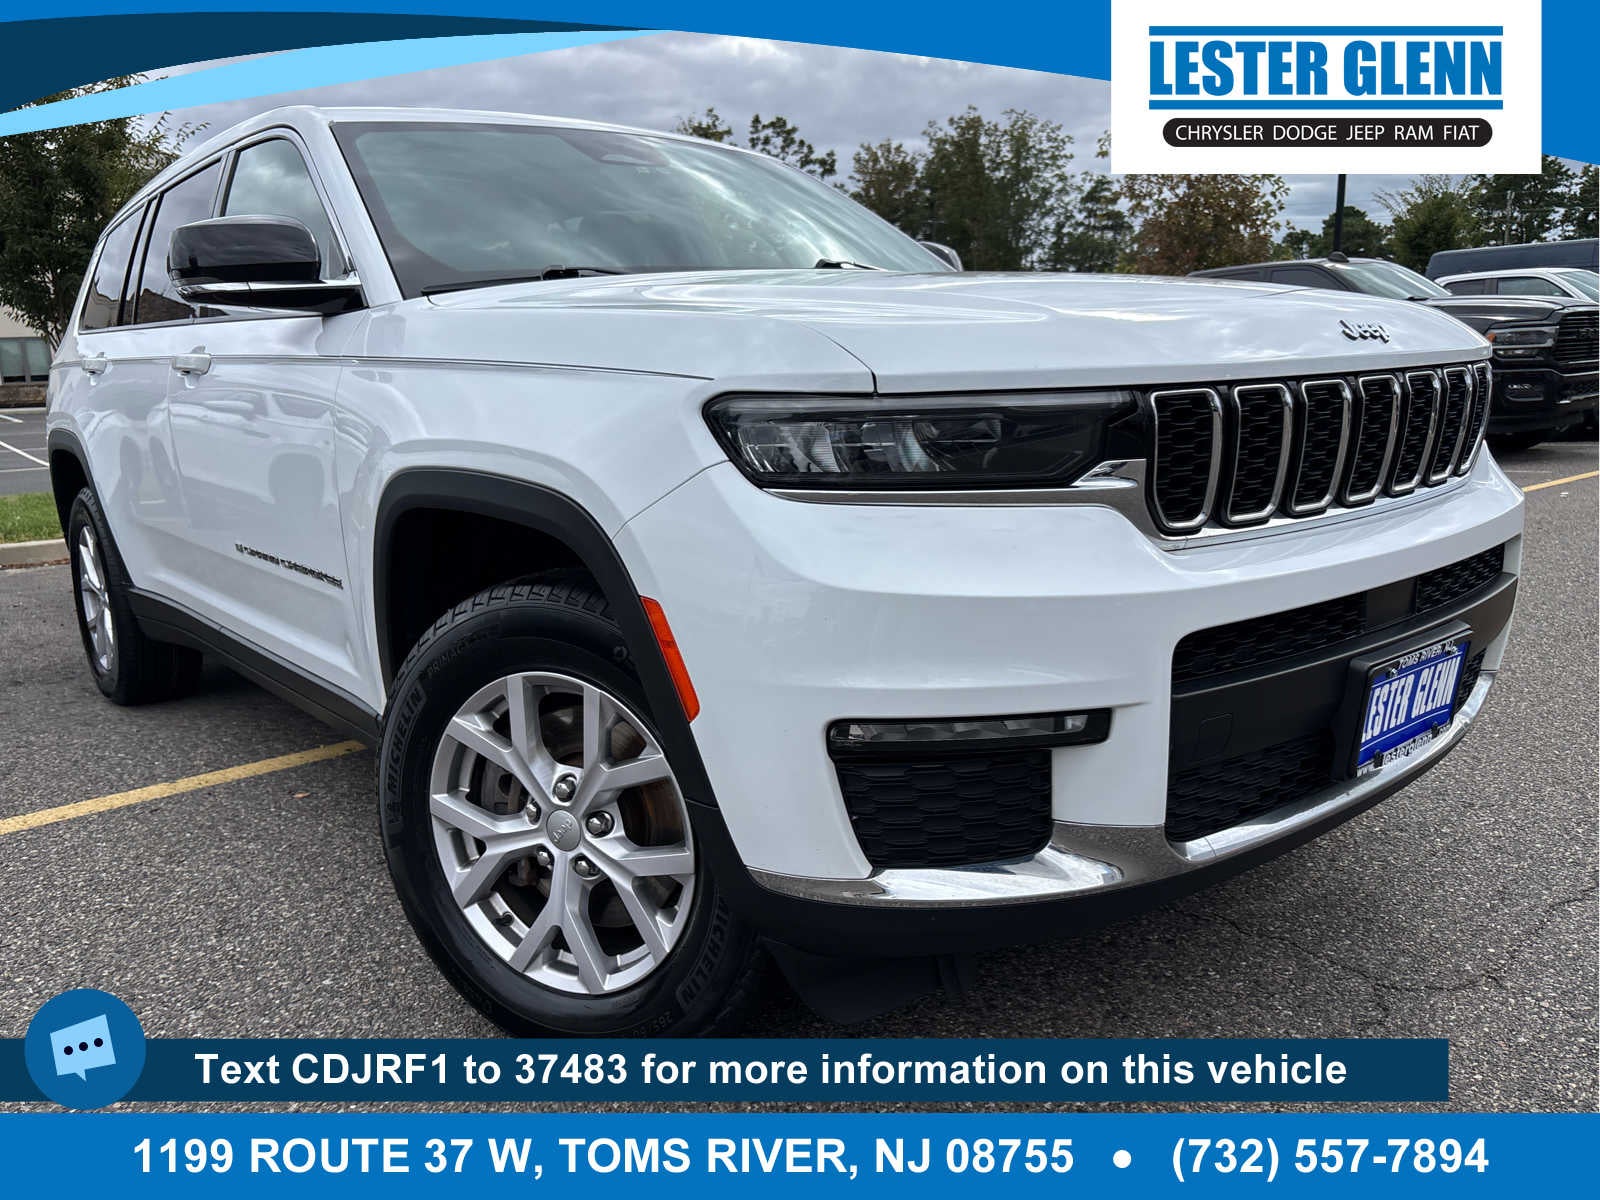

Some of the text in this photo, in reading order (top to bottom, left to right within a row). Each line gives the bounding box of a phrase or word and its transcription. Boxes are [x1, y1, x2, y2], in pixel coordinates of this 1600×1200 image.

[1338, 319, 1390, 344] Jeep
[388, 686, 423, 794] MICHELIN
[1361, 655, 1461, 743] LESTER GLENN
